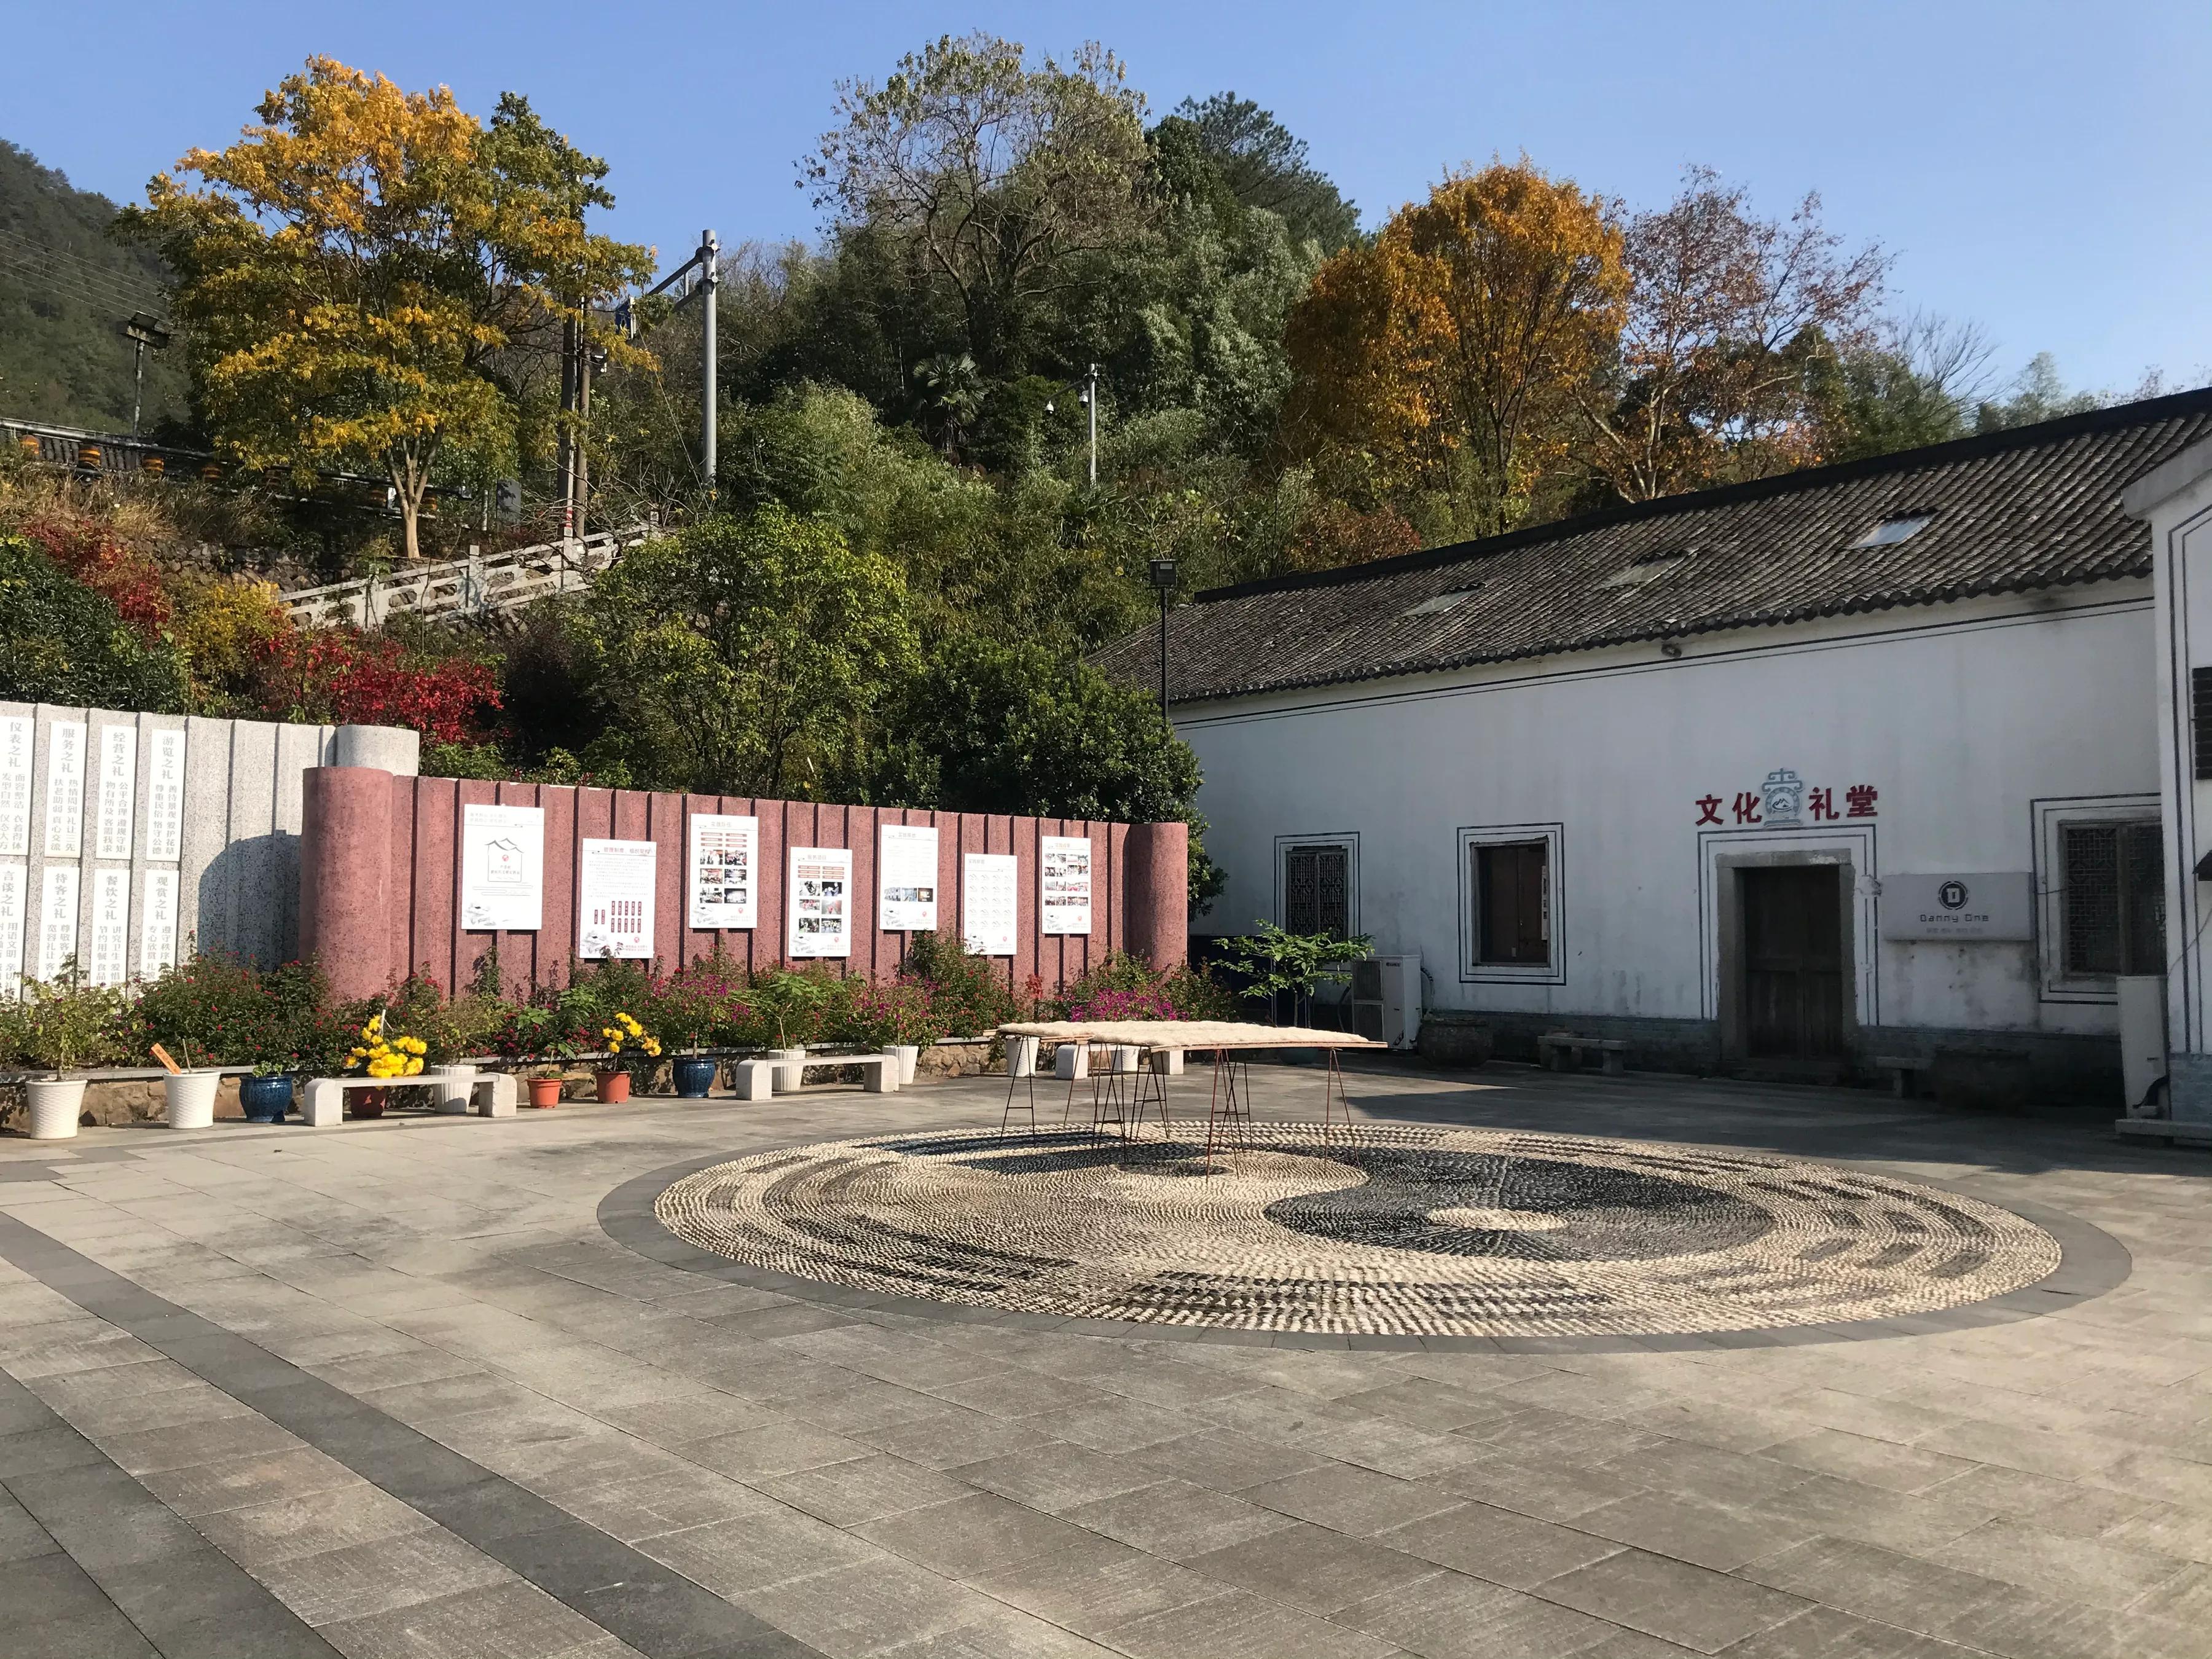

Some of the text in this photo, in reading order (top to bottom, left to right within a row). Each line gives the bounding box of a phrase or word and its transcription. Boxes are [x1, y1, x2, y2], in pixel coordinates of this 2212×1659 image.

[8, 721, 22, 767] 仪表之礼
[61, 728, 75, 773] 服务之礼
[112, 732, 126, 776] 经营之礼
[161, 736, 175, 779] 游览之礼
[0, 772, 12, 850] 发型自然 仪态大方
[12, 773, 25, 850] 面容整洁 衣着得体
[50, 778, 63, 852] 扶老助弱 真心交流
[65, 779, 78, 852] 热情周到 礼让三先
[117, 781, 128, 816] 公平合理
[152, 783, 164, 855] 尊重民俗 恪守公德
[165, 785, 177, 855] 善待景观 爱护花草
[1695, 785, 1878, 826] 文化礼堂
[1, 870, 15, 917] 言谈之礼
[53, 873, 68, 919] 待客之礼
[104, 875, 118, 920] 餐饮之礼
[155, 876, 168, 920] 观赏之礼
[6, 922, 18, 959] 用语文明
[1920, 914, 1959, 923] Danny
[45, 924, 57, 959] 宽容礼让
[97, 925, 108, 960] 节约用餐
[111, 925, 122, 960] 讲究卫生
[147, 926, 157, 960] 专心欣赏
[160, 926, 171, 960] 遵守秩序
